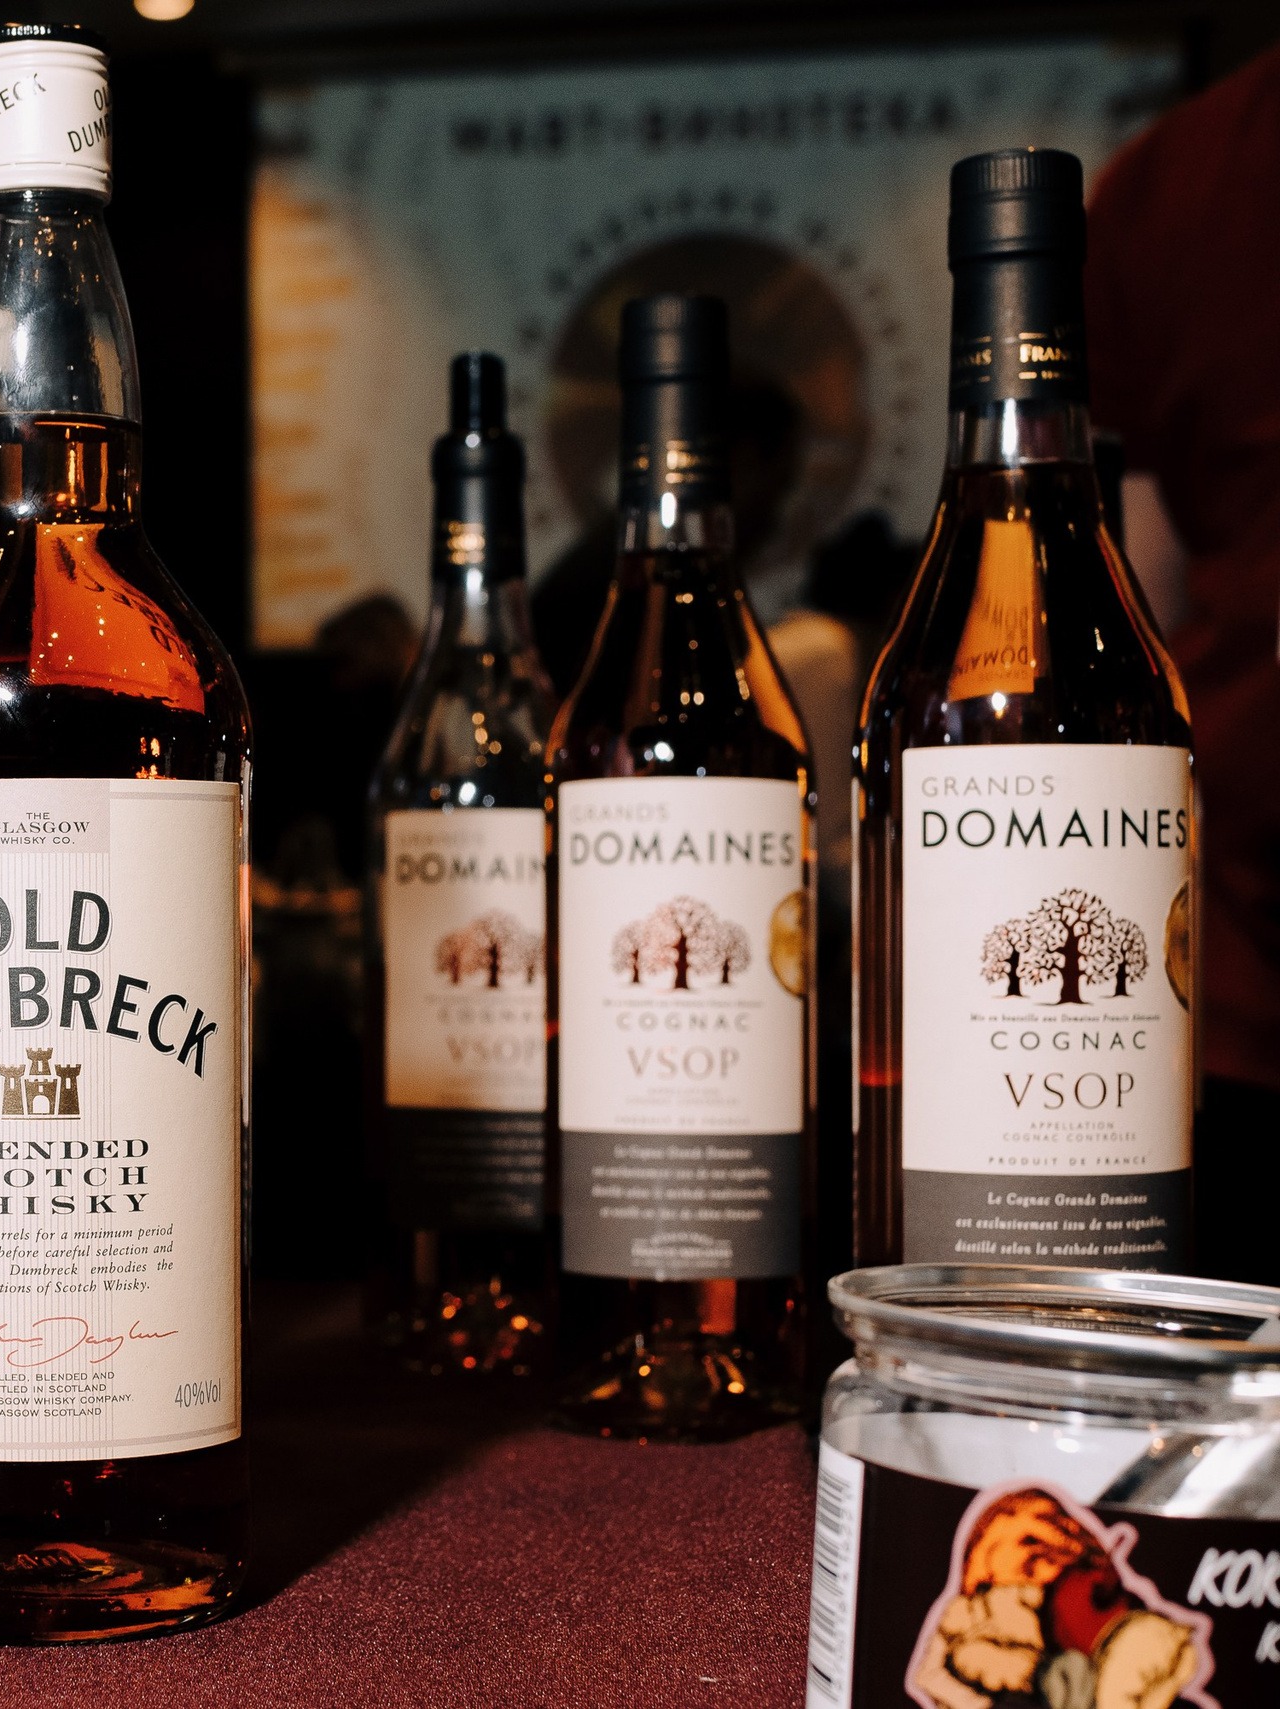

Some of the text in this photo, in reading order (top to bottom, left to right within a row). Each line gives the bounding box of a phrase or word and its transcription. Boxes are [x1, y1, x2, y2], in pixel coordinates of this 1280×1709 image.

[921, 775, 1056, 798] GRANDS
[26, 812, 50, 820] THE
[922, 807, 1187, 849] DOMAINES
[0, 836, 75, 845] WHISKY CO.
[571, 830, 795, 867] DOMAINES
[616, 1011, 751, 1032] COGNAC
[990, 1030, 1147, 1050] COGNAC
[626, 1046, 741, 1081] VSOP
[1003, 1071, 1135, 1110] VSOP
[1030, 1121, 1114, 1130] APPELLATION
[1003, 1132, 1058, 1142] COGNAC
[988, 1156, 1146, 1166] PRODUIT DE FRANCE
[1006, 1192, 1051, 1208] Cognac
[1054, 1192, 1096, 1206] Grands
[1089, 1217, 1102, 1231] de
[36, 1228, 55, 1243] for
[60, 1231, 68, 1240] a
[74, 1227, 133, 1239] minimum
[137, 1223, 174, 1240] period
[45, 1245, 90, 1260] careful
[96, 1244, 148, 1257] selection
[153, 1240, 174, 1254] and
[9, 1263, 78, 1276] Dumbreck
[90, 1261, 147, 1275] embodies
[157, 1258, 174, 1271] the
[36, 1280, 52, 1296] of
[54, 1280, 97, 1293] Scotch
[103, 1278, 150, 1293] Whisky.
[35, 1373, 88, 1381] BLENDED
[92, 1371, 115, 1380] AND
[33, 1385, 43, 1393] IN
[48, 1384, 107, 1393] SCOTLAND
[34, 1396, 76, 1405] WHISKY
[80, 1393, 134, 1404] COMPANY.
[44, 1407, 102, 1417] SCOTLAND
